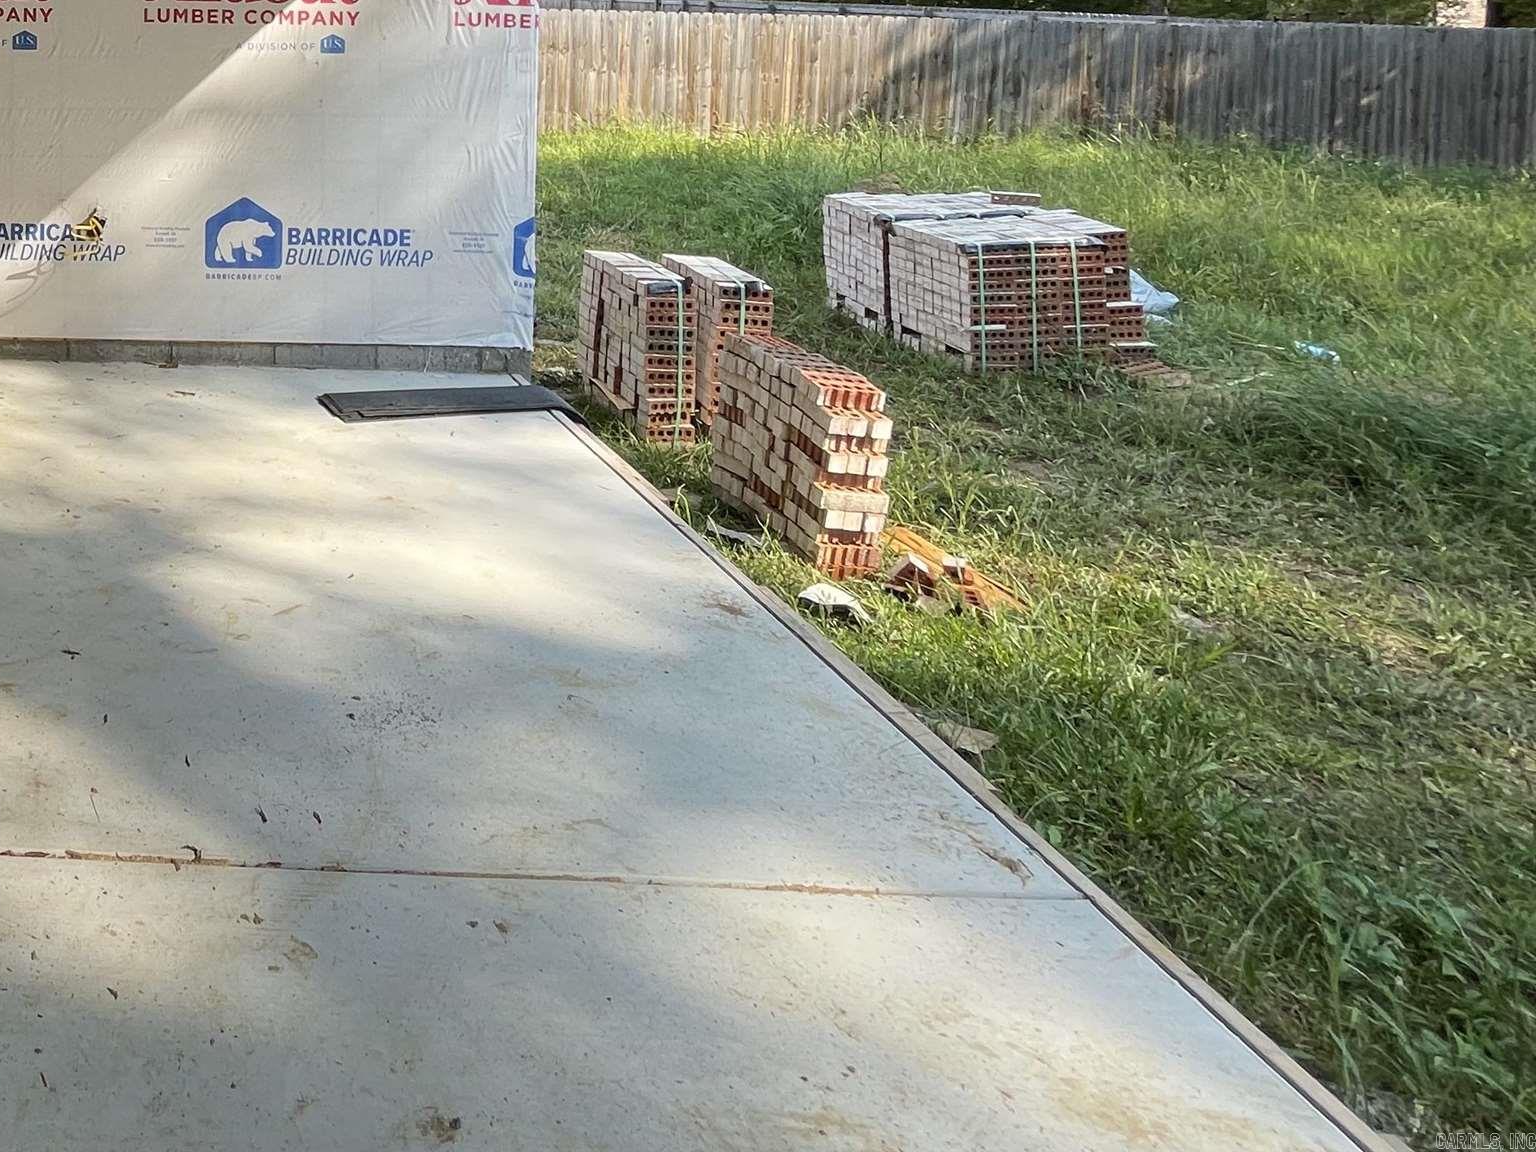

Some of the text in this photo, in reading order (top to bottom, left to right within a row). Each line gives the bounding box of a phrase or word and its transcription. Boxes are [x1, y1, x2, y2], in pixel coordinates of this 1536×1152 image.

[143, 7, 360, 26] LUMBER COMPANY
[247, 42, 296, 51] DIVISION
[300, 42, 316, 51] OF
[287, 227, 411, 247] BARRICADE
[72, 244, 126, 262] WRAP
[285, 248, 434, 268] BUILDING WRAP
